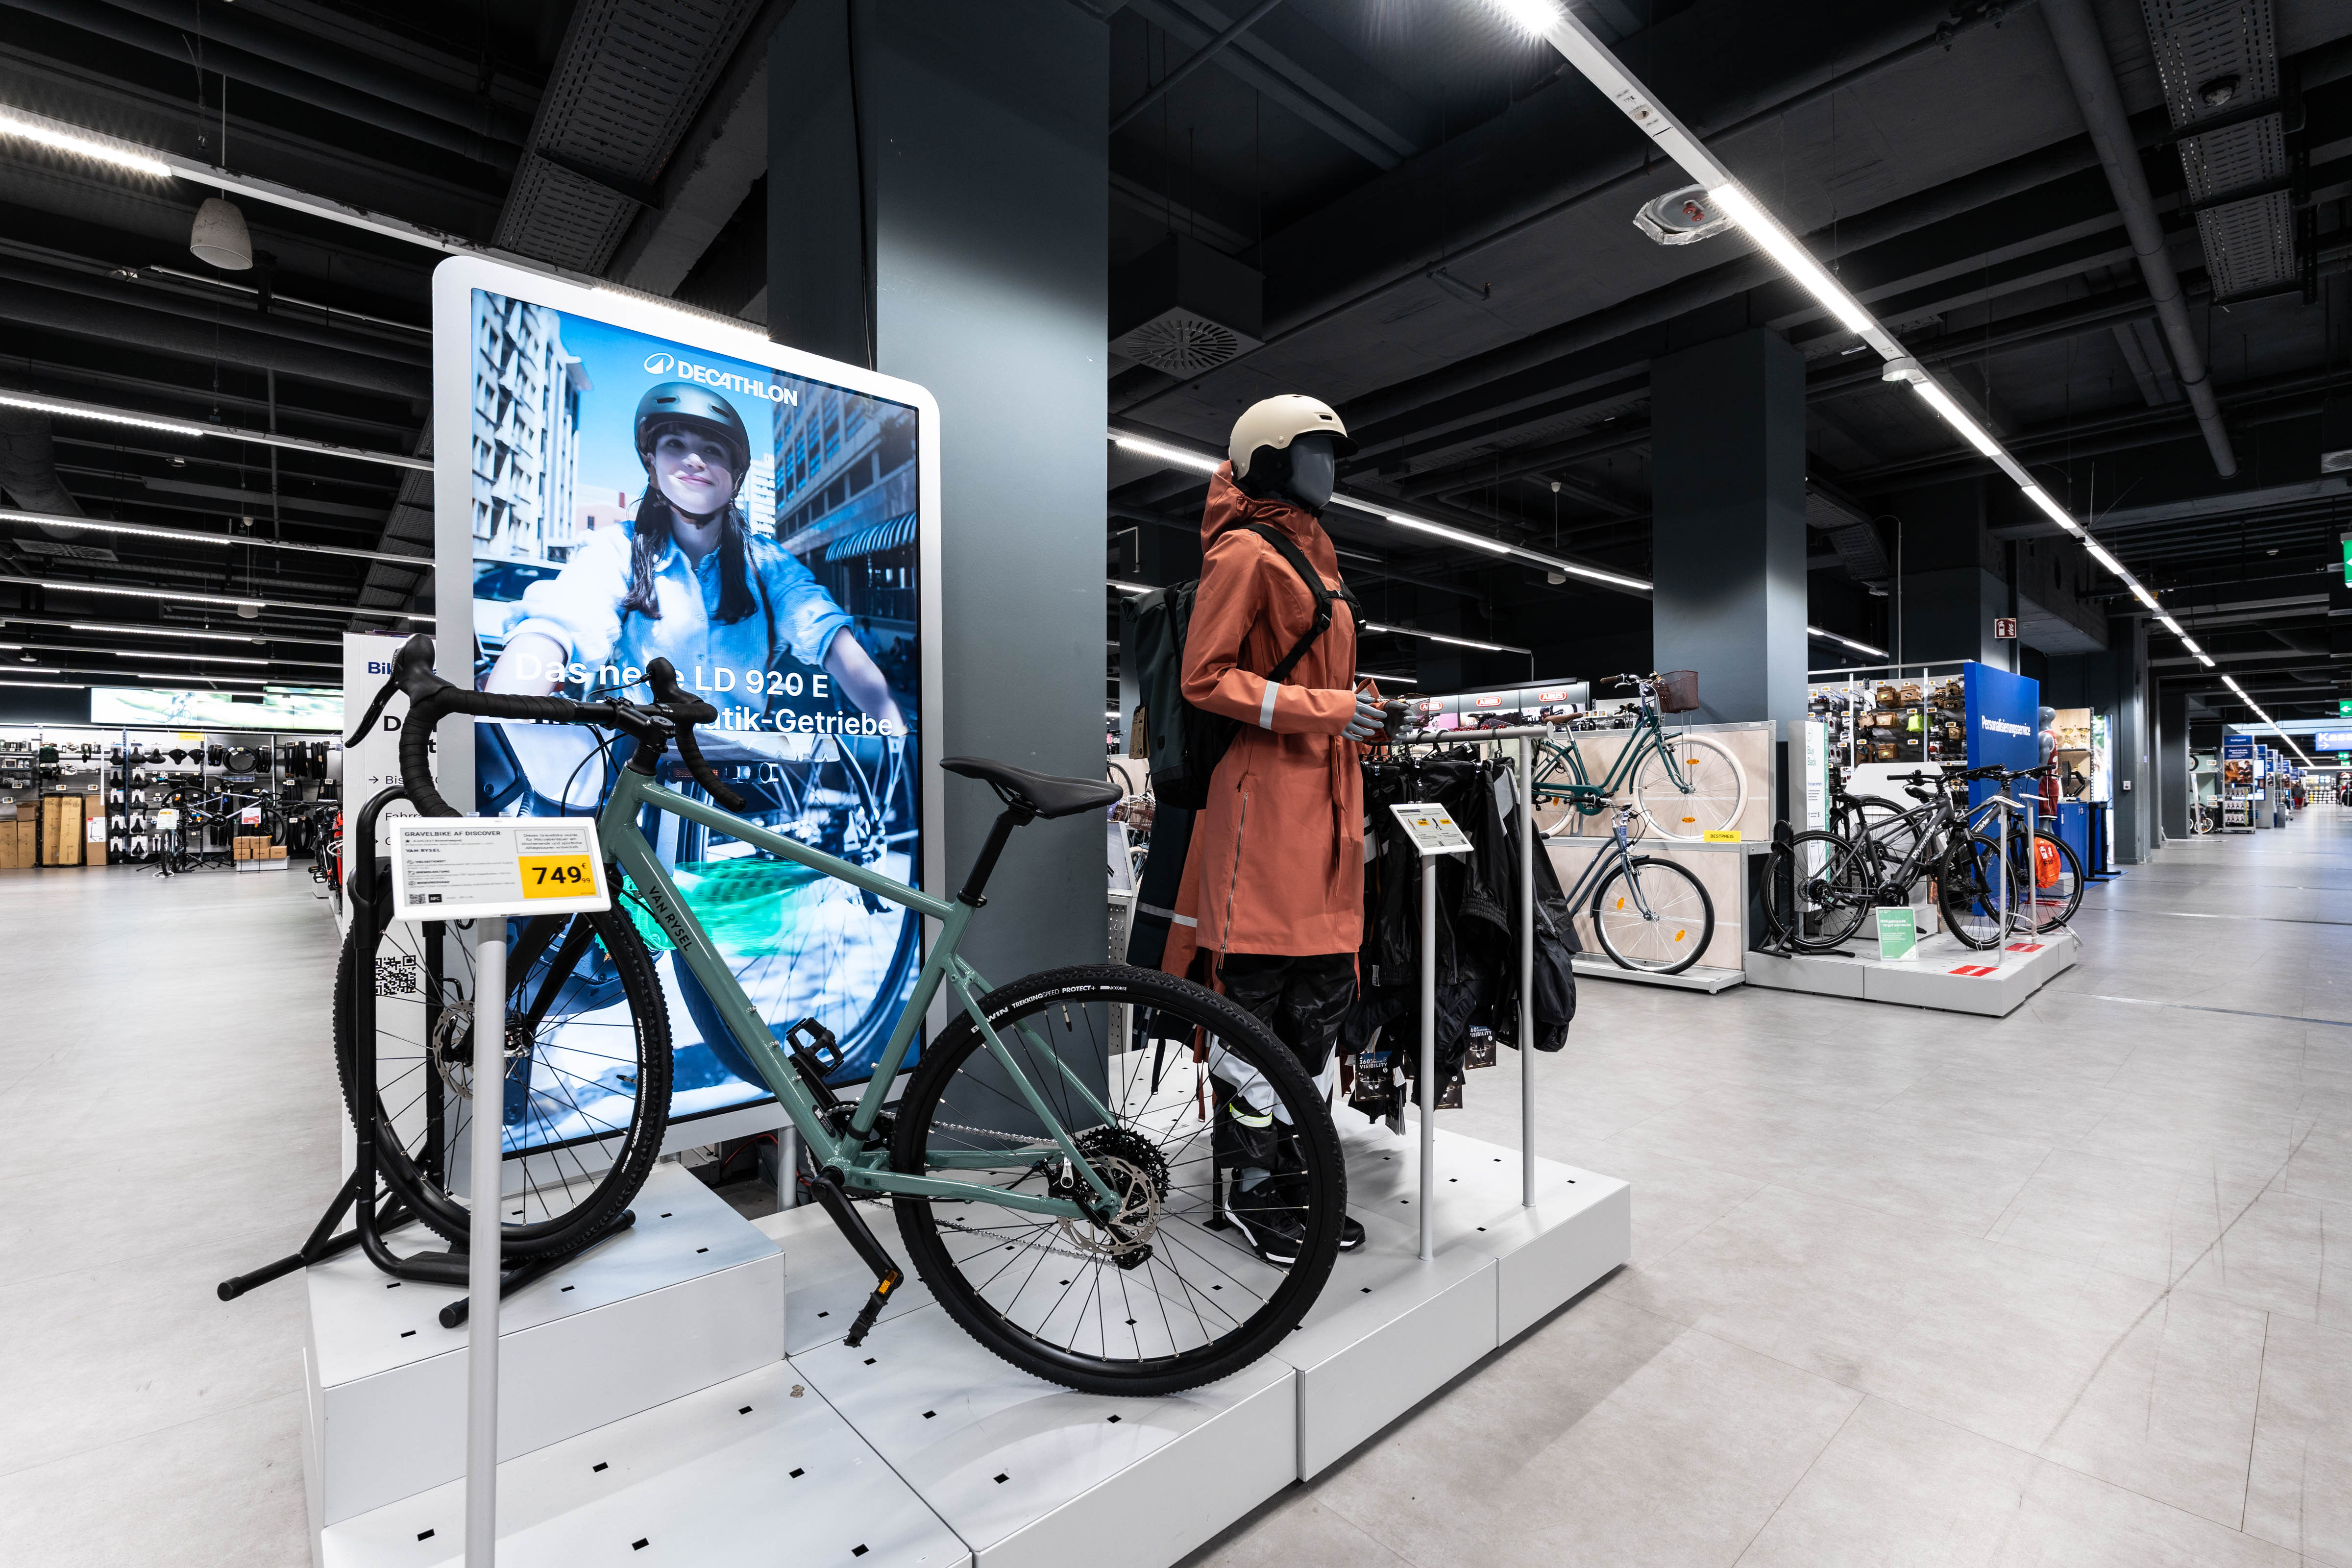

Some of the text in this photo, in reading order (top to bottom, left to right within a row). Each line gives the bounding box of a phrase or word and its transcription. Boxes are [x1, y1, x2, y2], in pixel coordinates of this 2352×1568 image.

[678, 360, 798, 407] DECATHLON
[516, 654, 828, 698] Das nee LD 920 E
[694, 705, 893, 736] atik-Getriebe
[1982, 715, 2031, 737] Personalisierungsservice
[1807, 757, 1816, 766] Back
[1975, 818, 1990, 833] rside
[1911, 825, 1936, 860] Riverside
[532, 866, 581, 884] 749
[649, 885, 692, 952] VAN RYSEL
[971, 1006, 1008, 1033] BWIN
[1012, 989, 1059, 1008] TREKKINGSPEED
